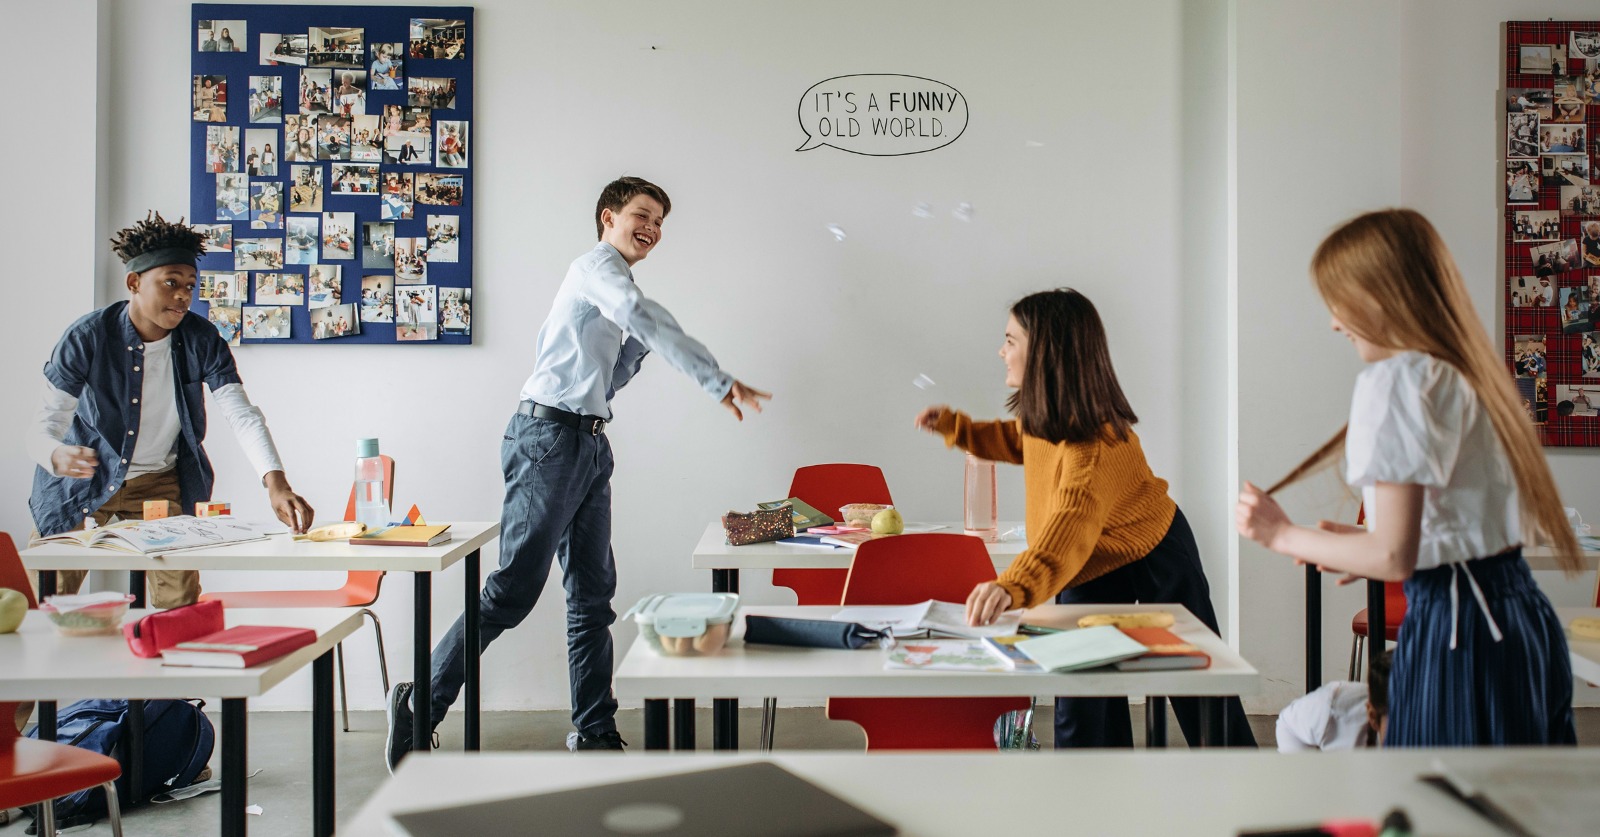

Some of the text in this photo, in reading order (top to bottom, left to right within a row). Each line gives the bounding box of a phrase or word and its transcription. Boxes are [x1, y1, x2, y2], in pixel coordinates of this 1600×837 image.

[815, 90, 958, 114] IT'S A FUNNY
[819, 117, 948, 138] OLD WORLD.
